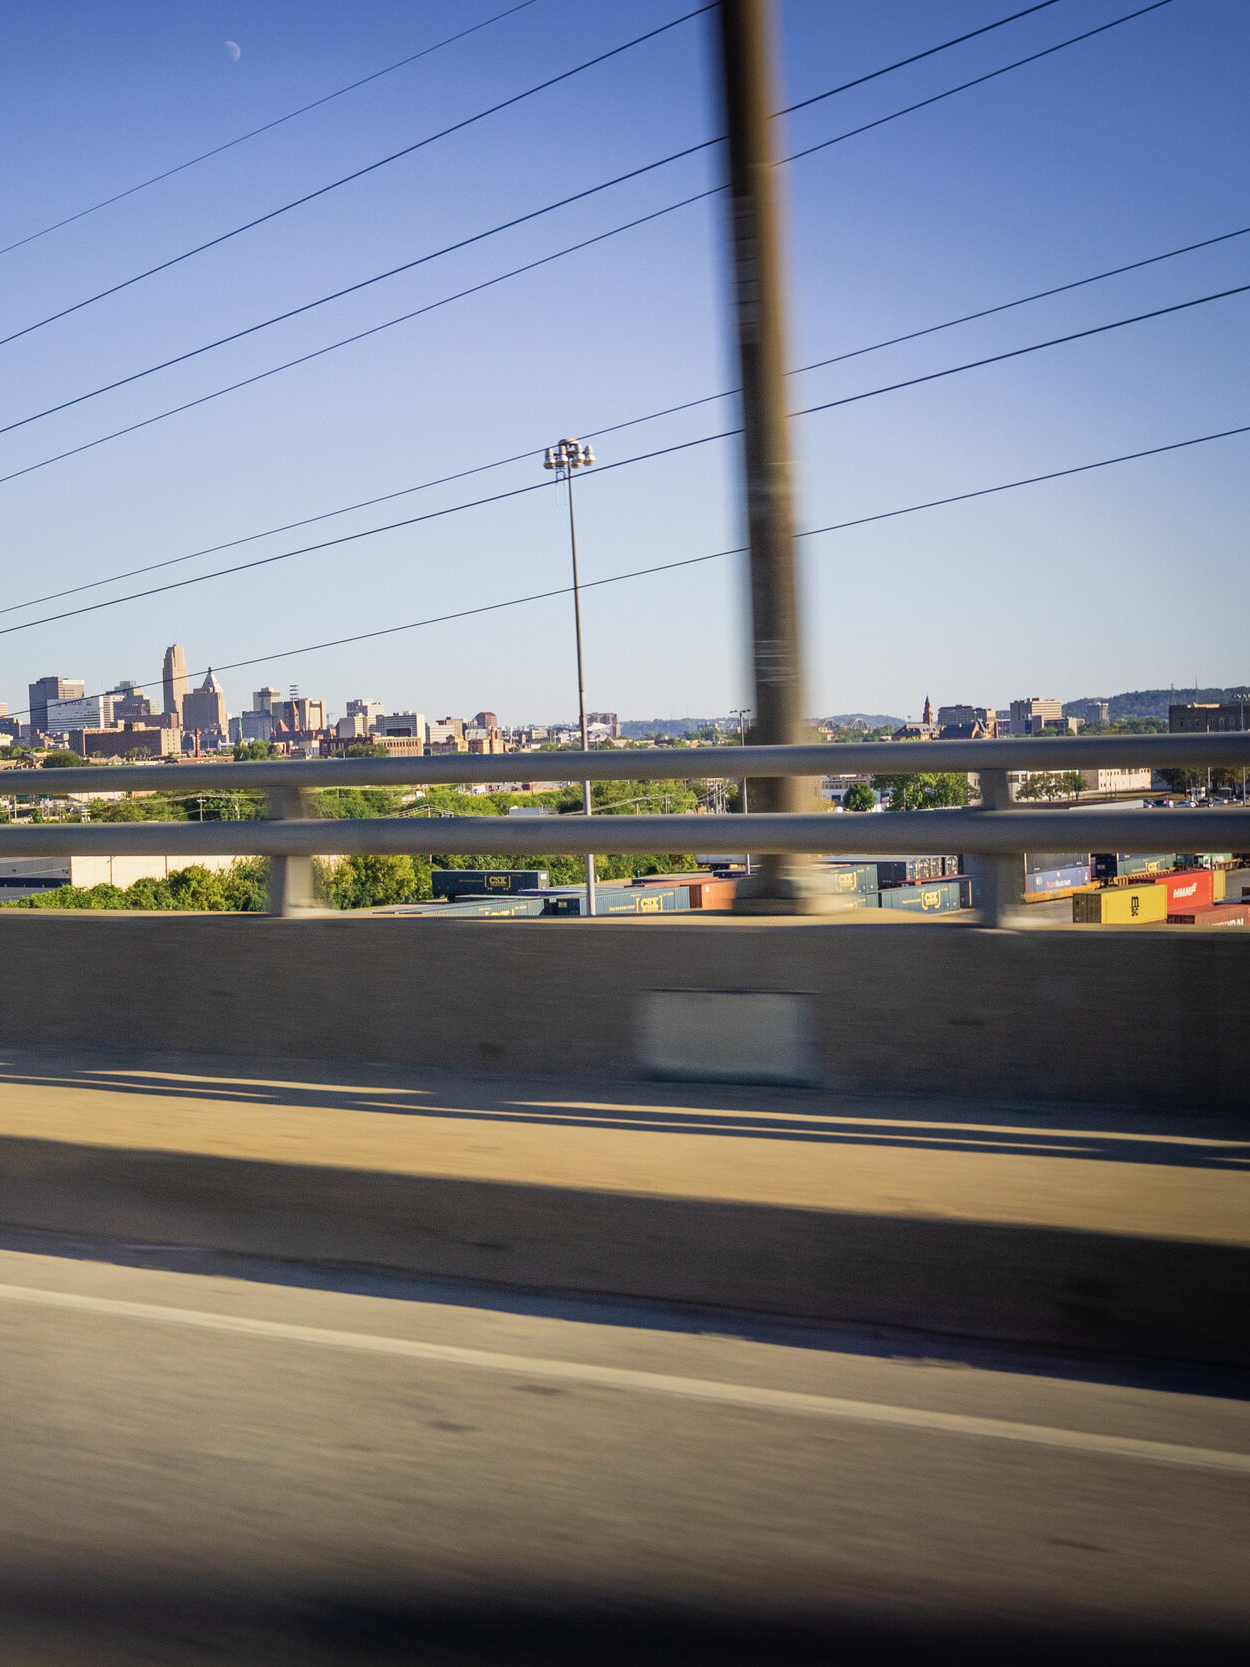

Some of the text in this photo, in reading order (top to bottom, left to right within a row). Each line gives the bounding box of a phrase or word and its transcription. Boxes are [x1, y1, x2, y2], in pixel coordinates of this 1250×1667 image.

[490, 876, 507, 884] CSX
[925, 892, 938, 901] CSX
[641, 897, 659, 908] CSX
